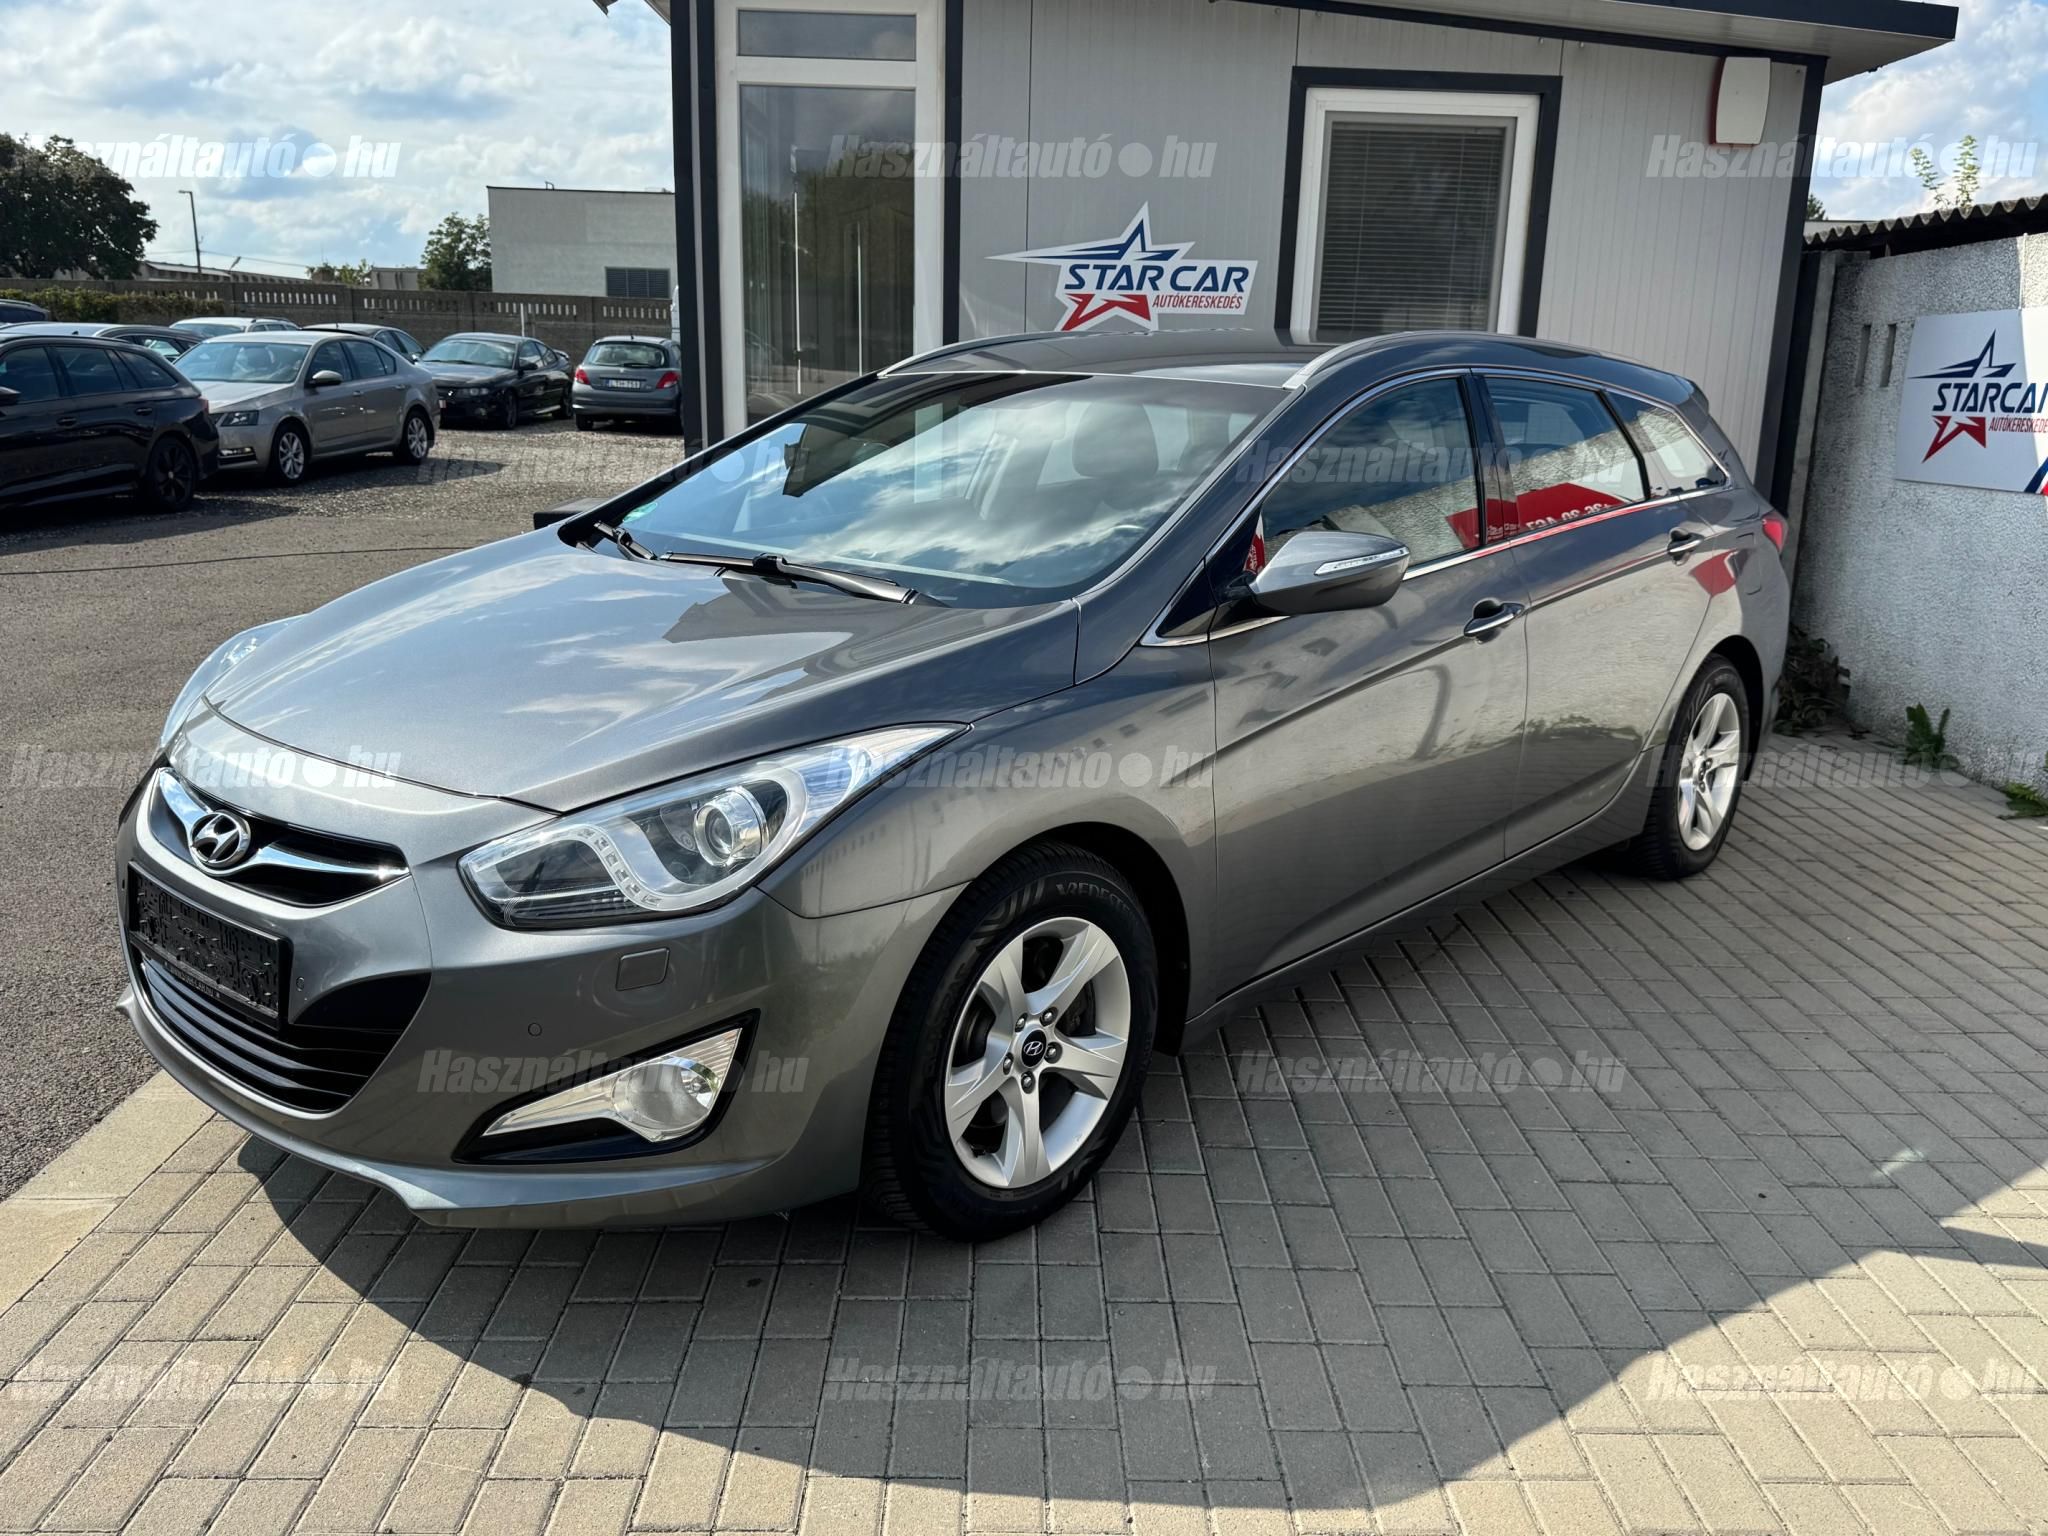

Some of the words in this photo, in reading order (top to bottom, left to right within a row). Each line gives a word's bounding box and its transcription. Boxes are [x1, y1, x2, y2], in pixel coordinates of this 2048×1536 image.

[1064, 264, 1164, 291] STAR
[1169, 266, 1249, 292] CAR
[1152, 293, 1243, 308] AUTÓKERESKEDÉS
